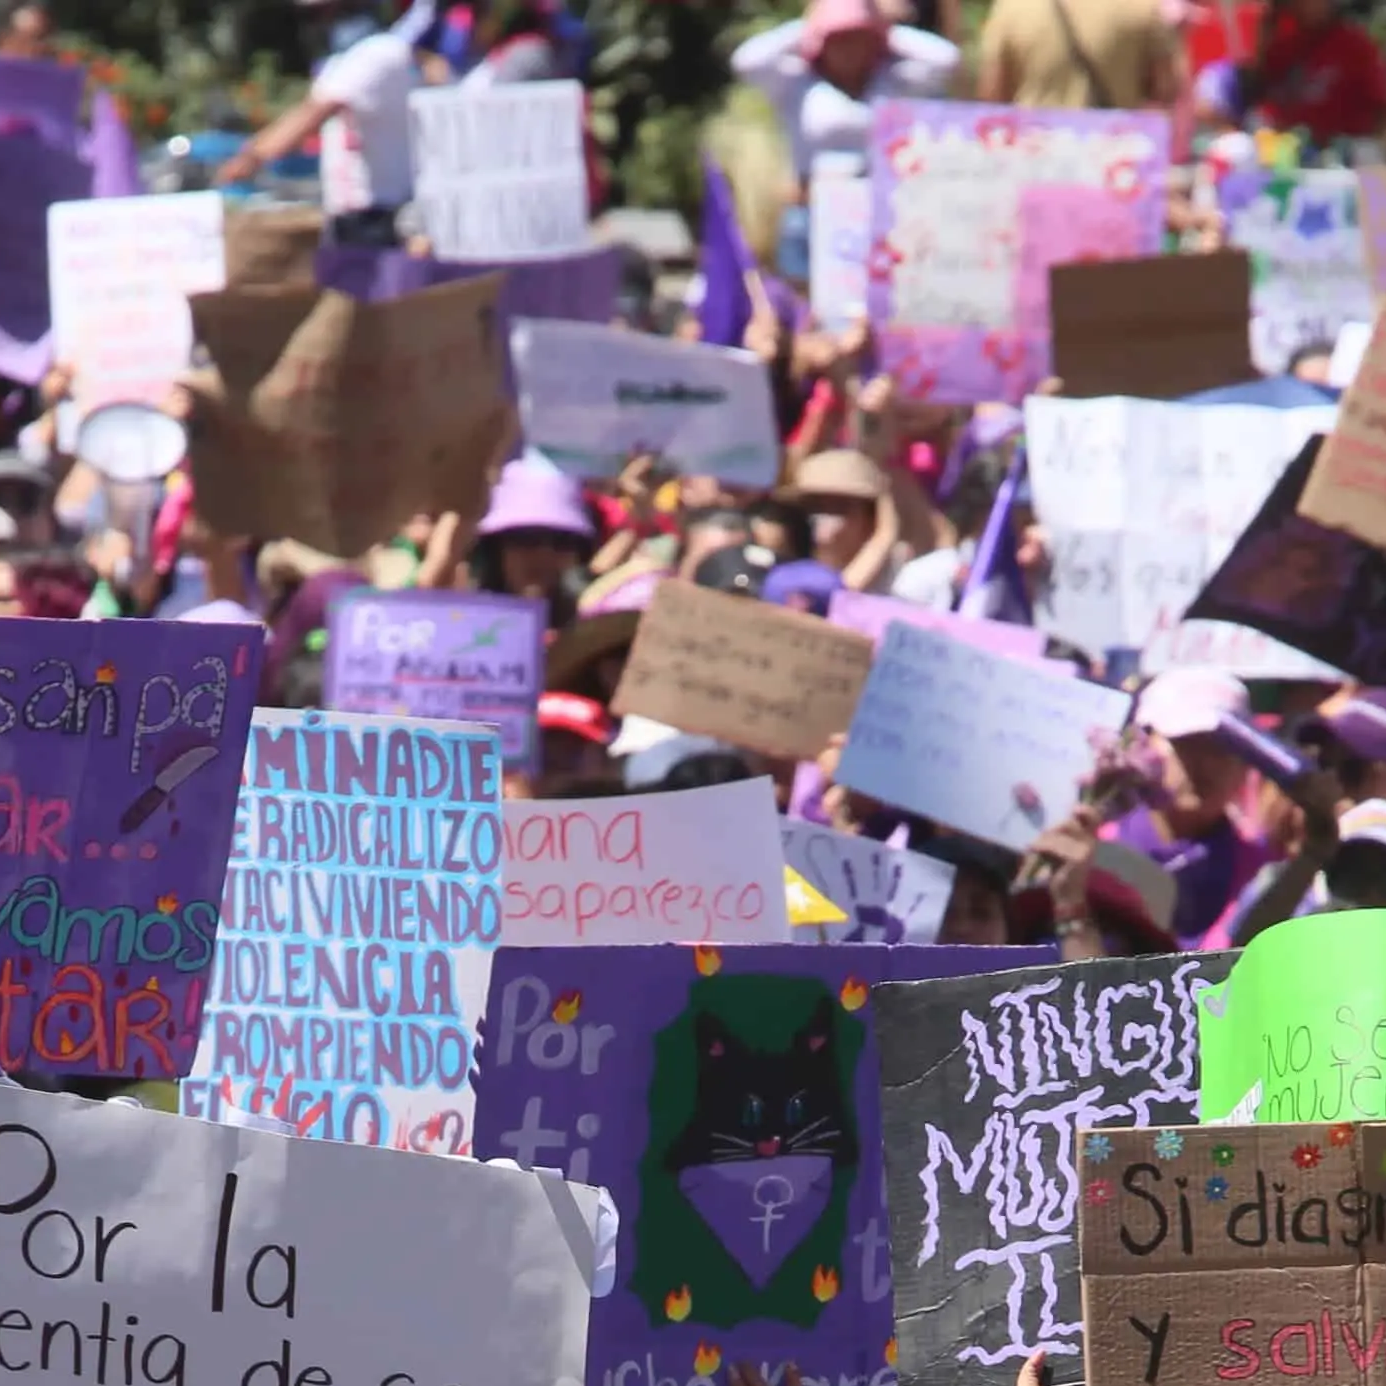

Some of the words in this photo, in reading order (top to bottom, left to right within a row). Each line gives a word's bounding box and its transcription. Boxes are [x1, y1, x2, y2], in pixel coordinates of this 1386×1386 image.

[256, 796, 502, 874] RADICALIZO
[219, 938, 455, 1017] IOLENCIA
[214, 1010, 469, 1089] ROMPIENDO
[496, 974, 617, 1077] Por
[960, 961, 1213, 1104] NINGU
[500, 1094, 603, 1184] ti
[210, 1171, 299, 1320] la
[1118, 1160, 1195, 1258] Si
